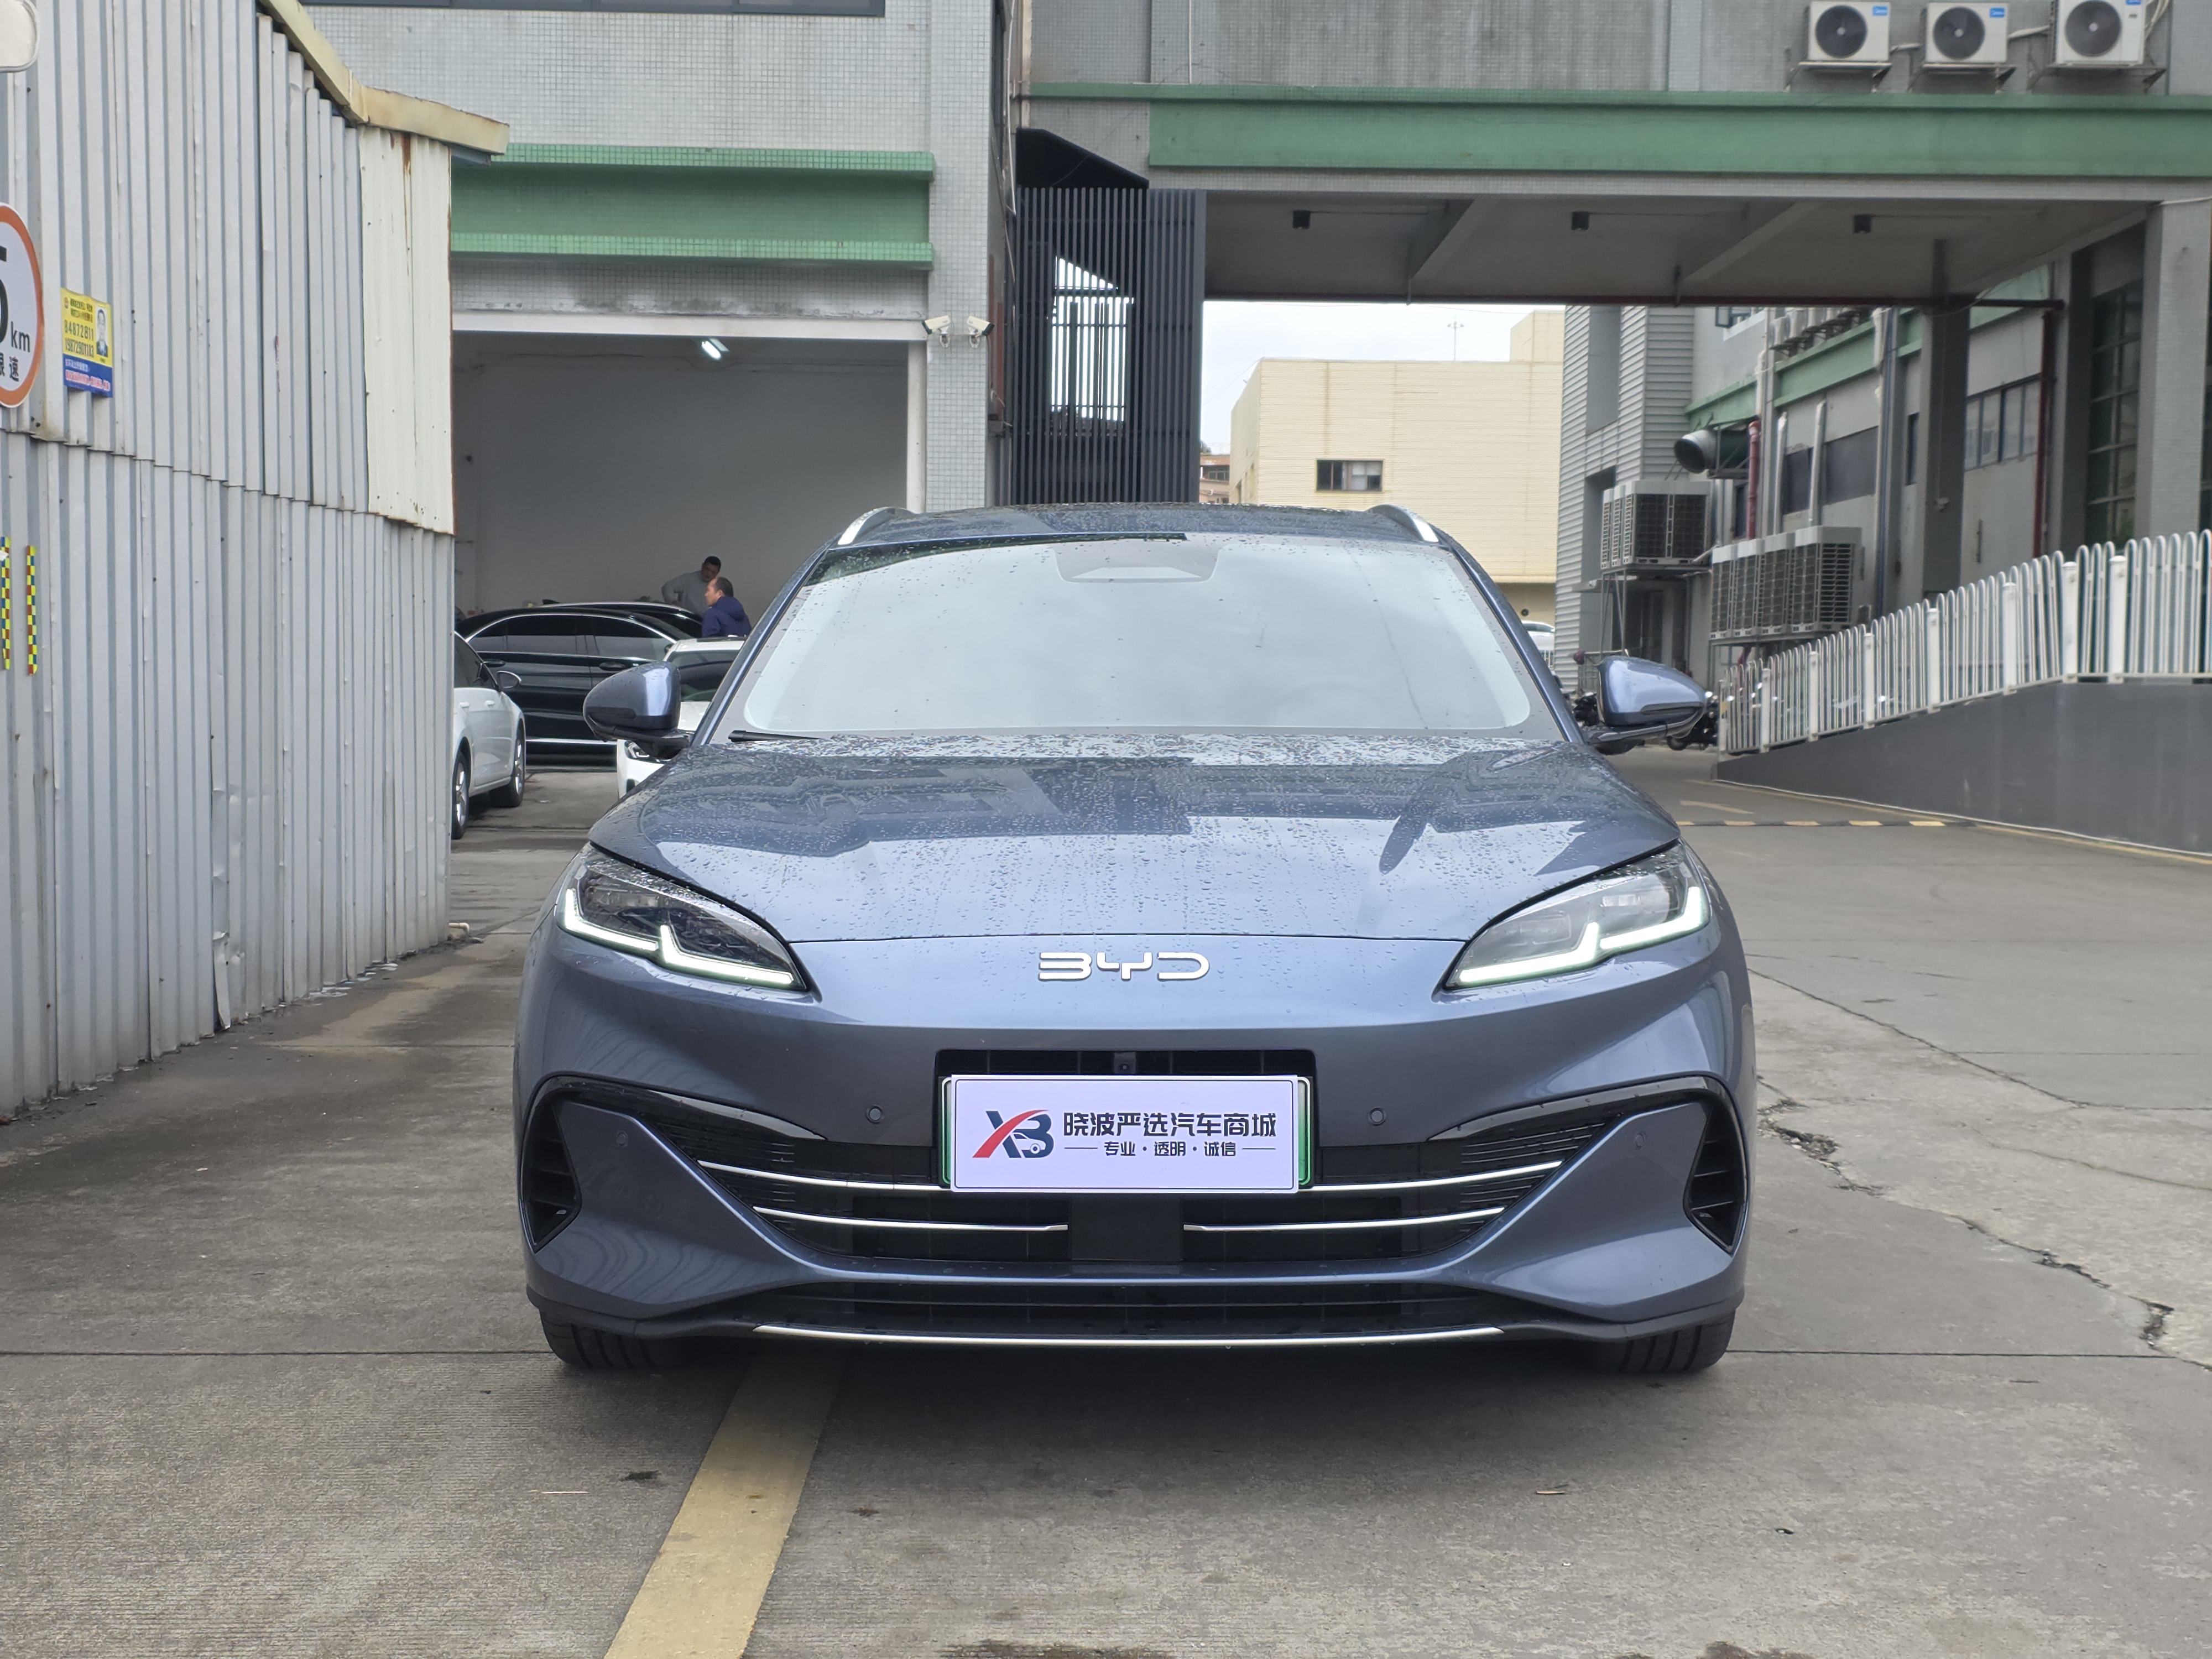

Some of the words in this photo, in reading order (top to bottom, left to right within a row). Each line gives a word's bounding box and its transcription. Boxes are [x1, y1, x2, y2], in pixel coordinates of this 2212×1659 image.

[11, 321, 30, 353] km
[1039, 952, 1209, 981] BYD
[1063, 1112, 1277, 1137] 晓波严选汽车商城
